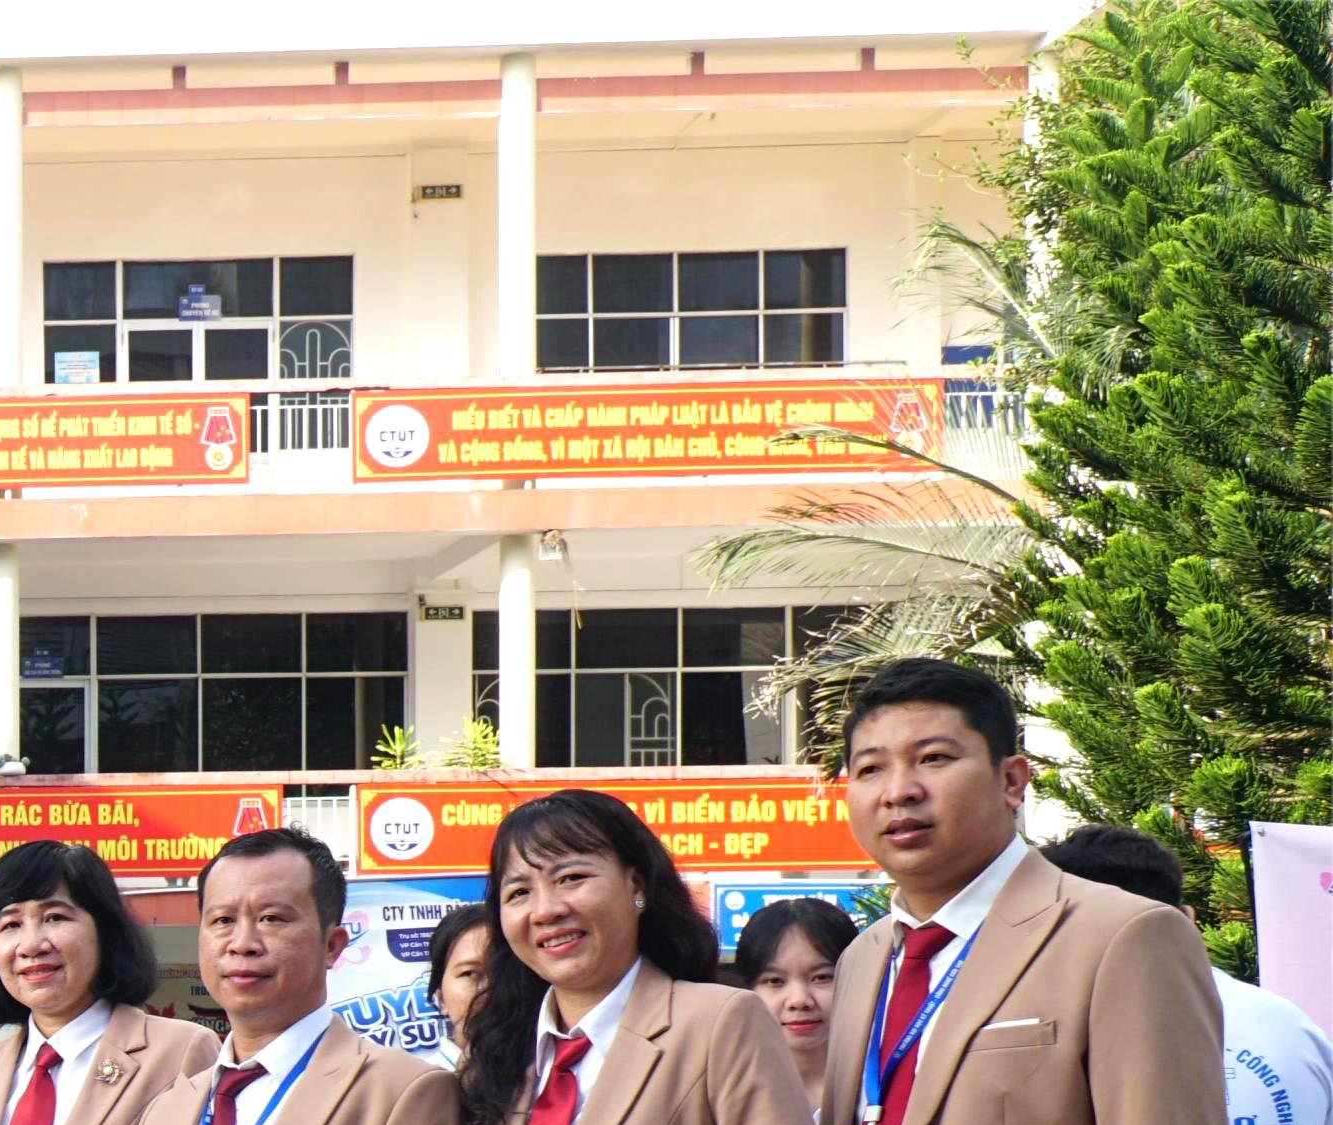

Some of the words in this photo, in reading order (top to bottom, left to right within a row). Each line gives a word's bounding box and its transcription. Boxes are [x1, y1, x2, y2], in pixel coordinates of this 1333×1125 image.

[22, 412, 39, 438] SỐ
[158, 411, 174, 436] TẾ
[175, 409, 192, 435] SỐ
[452, 403, 484, 430] HIỂU
[488, 404, 519, 429] BIẾT
[523, 405, 541, 428] VÀ
[545, 401, 584, 428] CHẤP
[630, 401, 669, 426] PHÁP
[672, 401, 709, 429] LUẬT
[711, 399, 729, 424] LÀ
[732, 398, 761, 424] BẢO
[765, 399, 782, 428] VỆ
[379, 430, 415, 442] CTUT
[438, 440, 457, 463] VÀ
[460, 438, 501, 466] CỘNG
[550, 437, 565, 460] VÌ
[603, 435, 622, 459] XÃ
[725, 433, 765, 457] CÔNG
[30, 447, 45, 470] VÀ
[0, 802, 42, 826] RÁC
[49, 801, 92, 826] BỪA
[98, 800, 140, 827] BÃI,
[441, 800, 502, 827] CÙNG
[644, 797, 665, 824] VÌ
[671, 793, 725, 823] BIỂN
[730, 793, 777, 823] ĐẢO
[782, 795, 830, 827] VIỆT
[384, 823, 420, 835] CTUT
[97, 835, 137, 861] MÔI
[144, 832, 230, 860] TRƯỜNG
[725, 833, 769, 859] ĐẸP
[382, 905, 404, 922] CTY
[410, 903, 442, 921] TNHH
[1236, 1049, 1280, 1089] CÔNG
